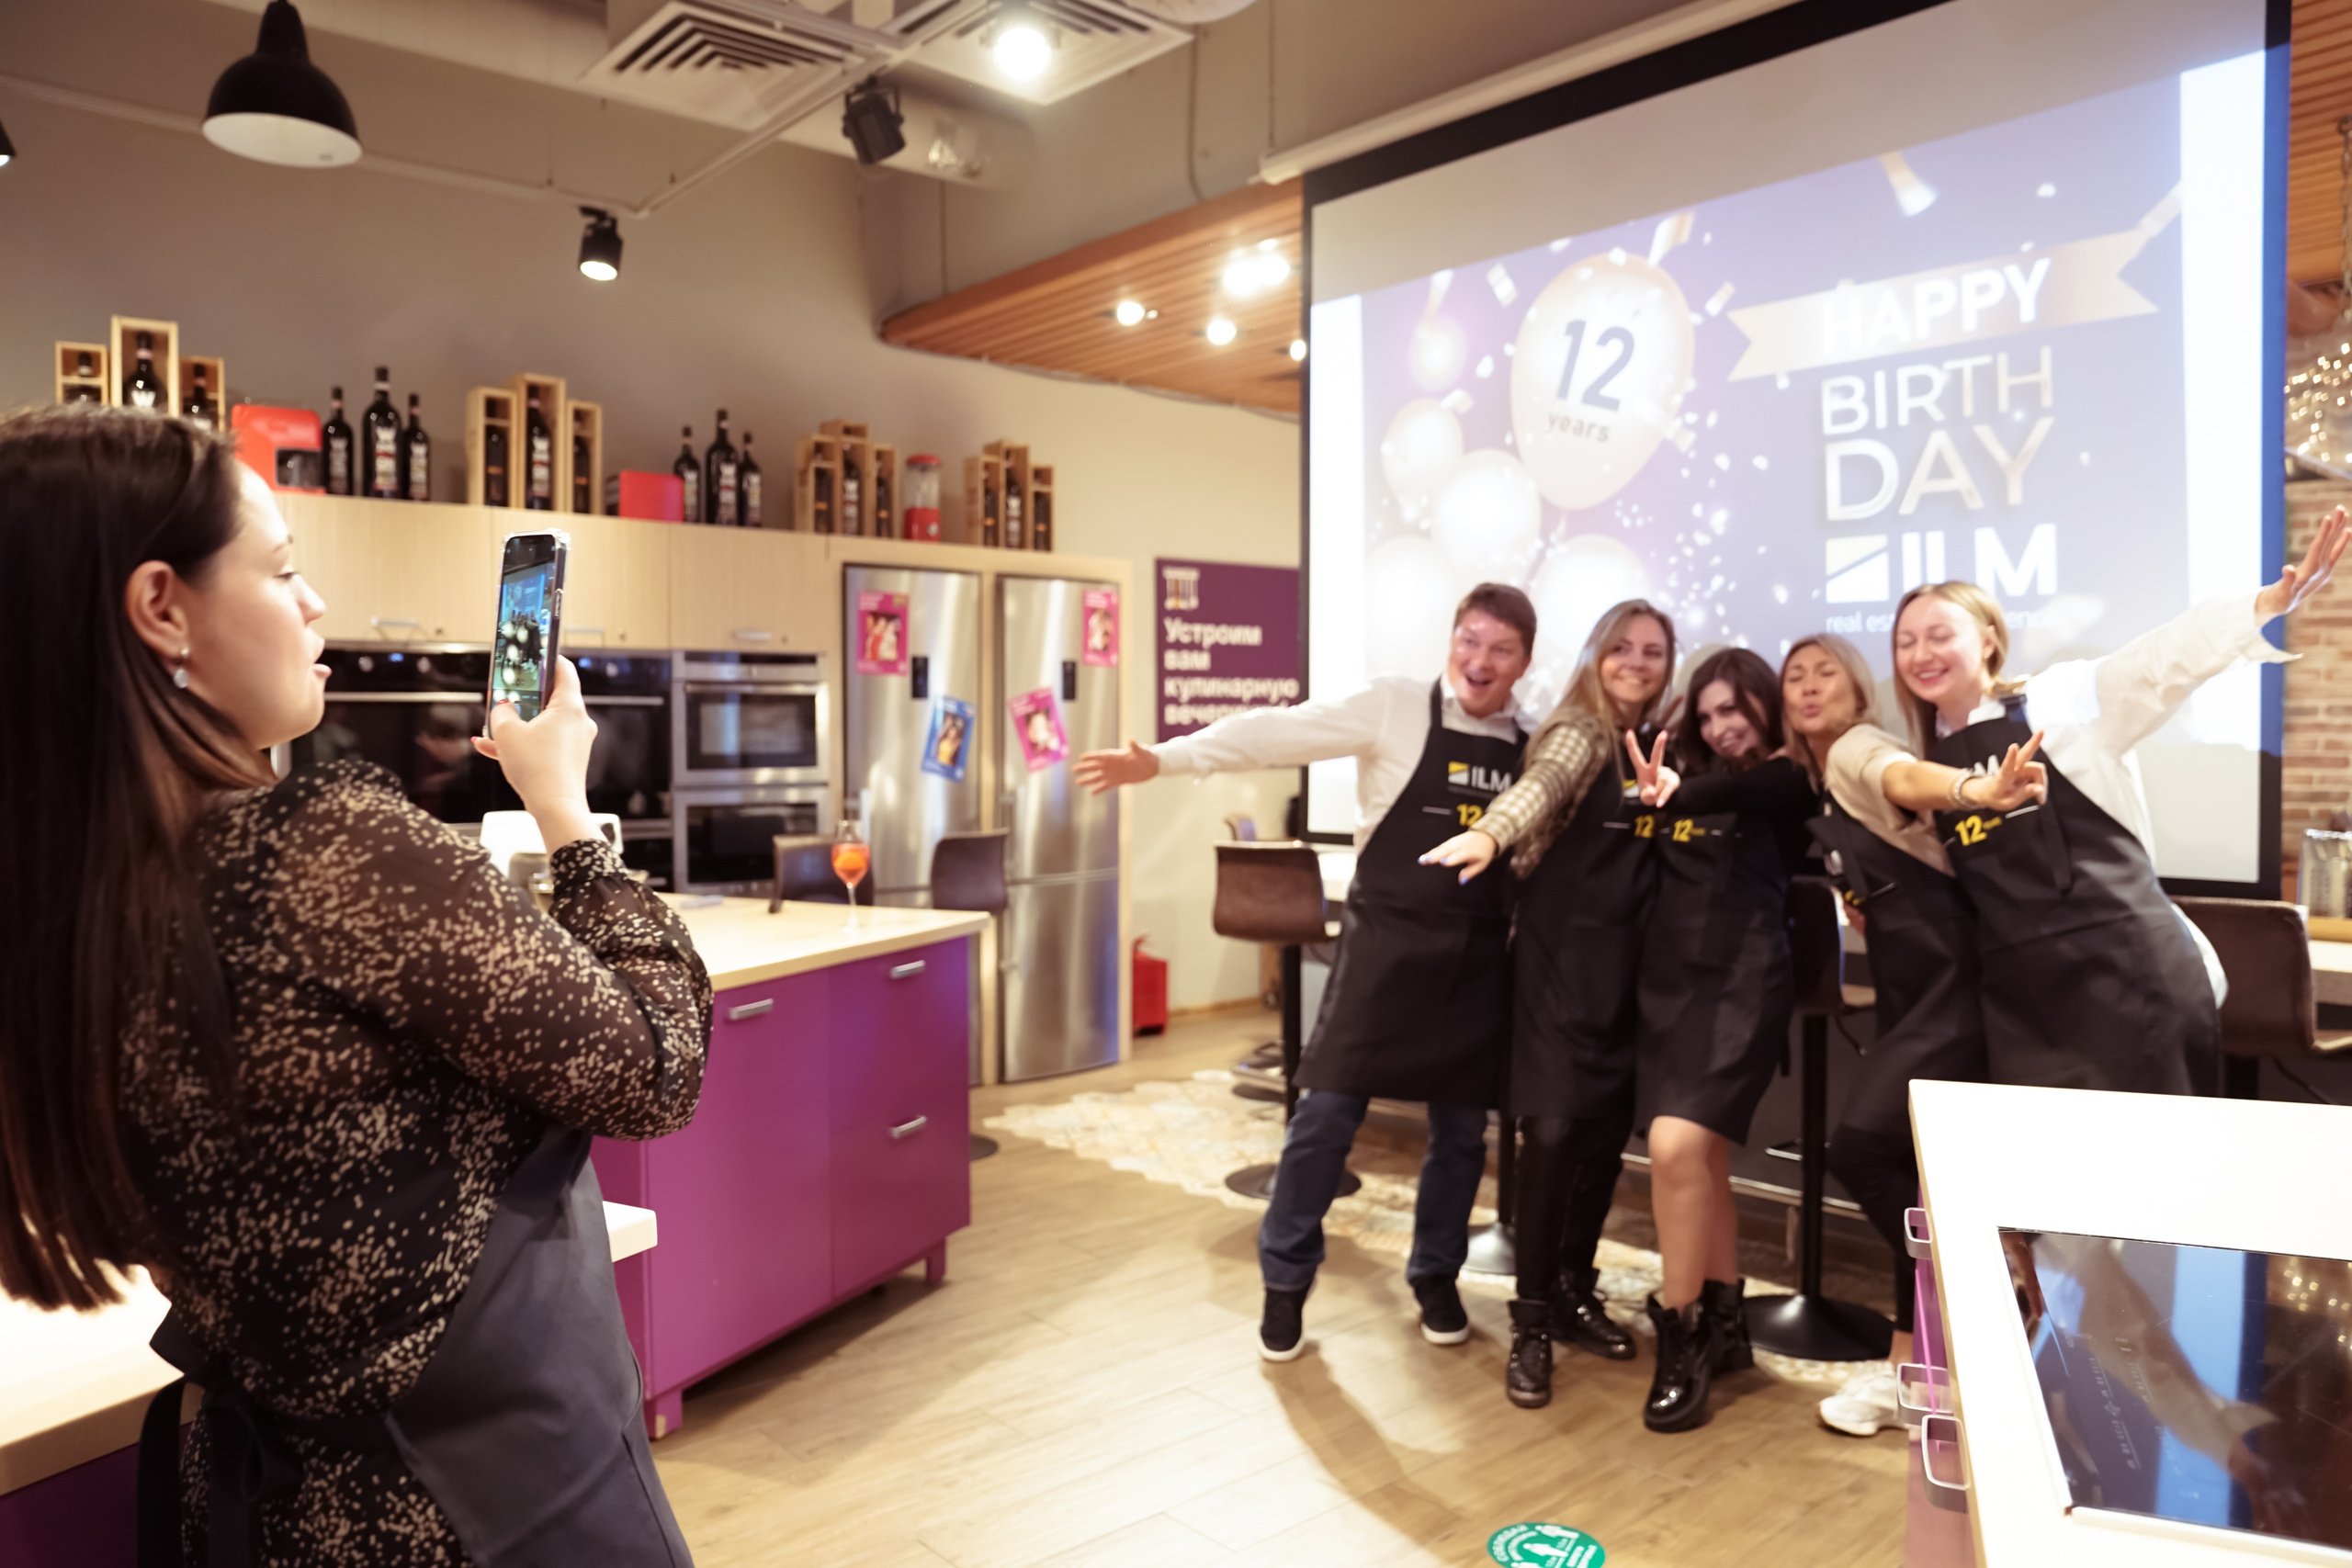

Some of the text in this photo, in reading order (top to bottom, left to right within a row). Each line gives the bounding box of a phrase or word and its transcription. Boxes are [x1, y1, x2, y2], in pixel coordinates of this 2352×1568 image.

[1822, 258, 2051, 355] HAPPY
[1556, 319, 1634, 412] 12
[1822, 345, 2052, 435] BIRTH
[1545, 412, 1611, 443] years
[1825, 416, 2055, 522] DAY
[1163, 616, 1262, 649] Устроим
[1826, 610, 1862, 634] real
[1163, 649, 1211, 671] вам
[1163, 676, 1299, 704] кулинарную
[1471, 765, 1511, 792] ILM
[1456, 804, 1483, 827] 12
[1634, 815, 1654, 838] 12
[1672, 818, 1693, 842] 12
[1955, 815, 1987, 846] 12
